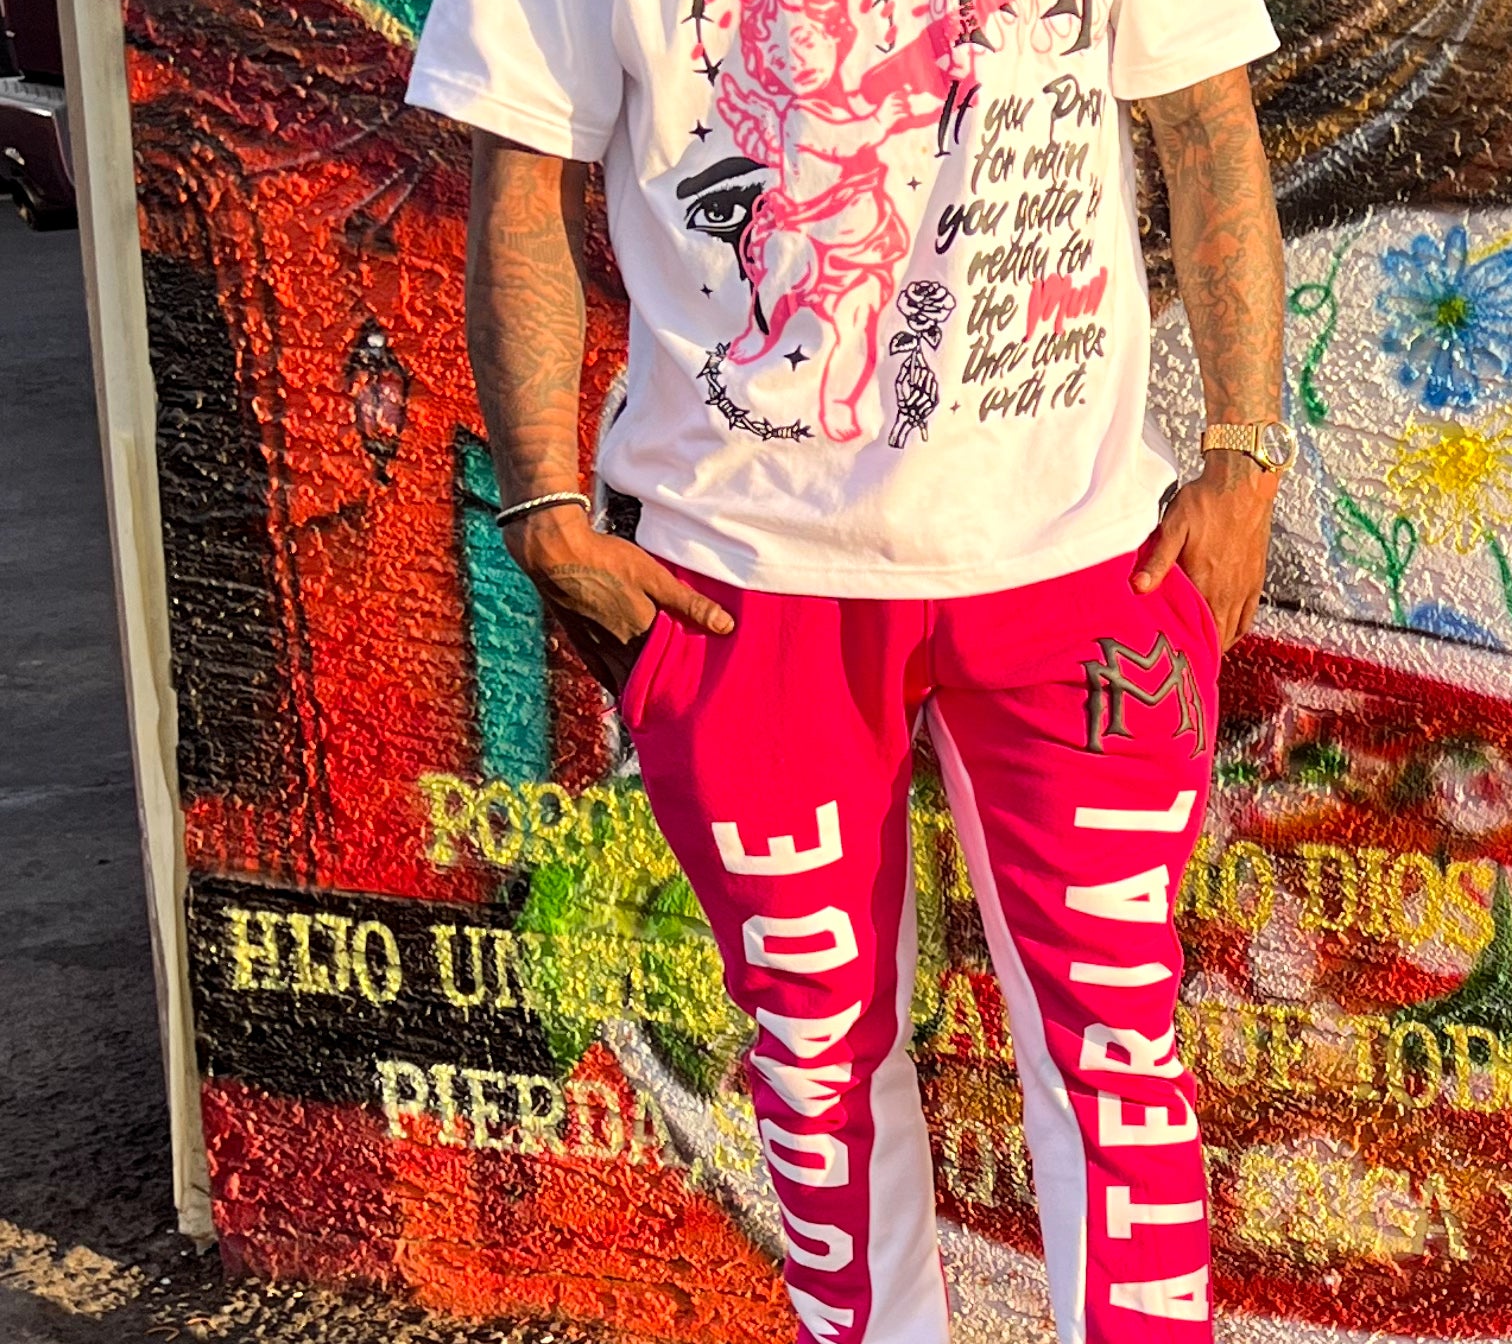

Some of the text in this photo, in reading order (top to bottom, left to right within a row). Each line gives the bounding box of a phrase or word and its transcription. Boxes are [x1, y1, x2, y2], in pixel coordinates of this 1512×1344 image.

[934, 79, 982, 158] If
[934, 203, 1010, 256] you
[966, 285, 1019, 336] the
[222, 906, 402, 1010] HIJO
